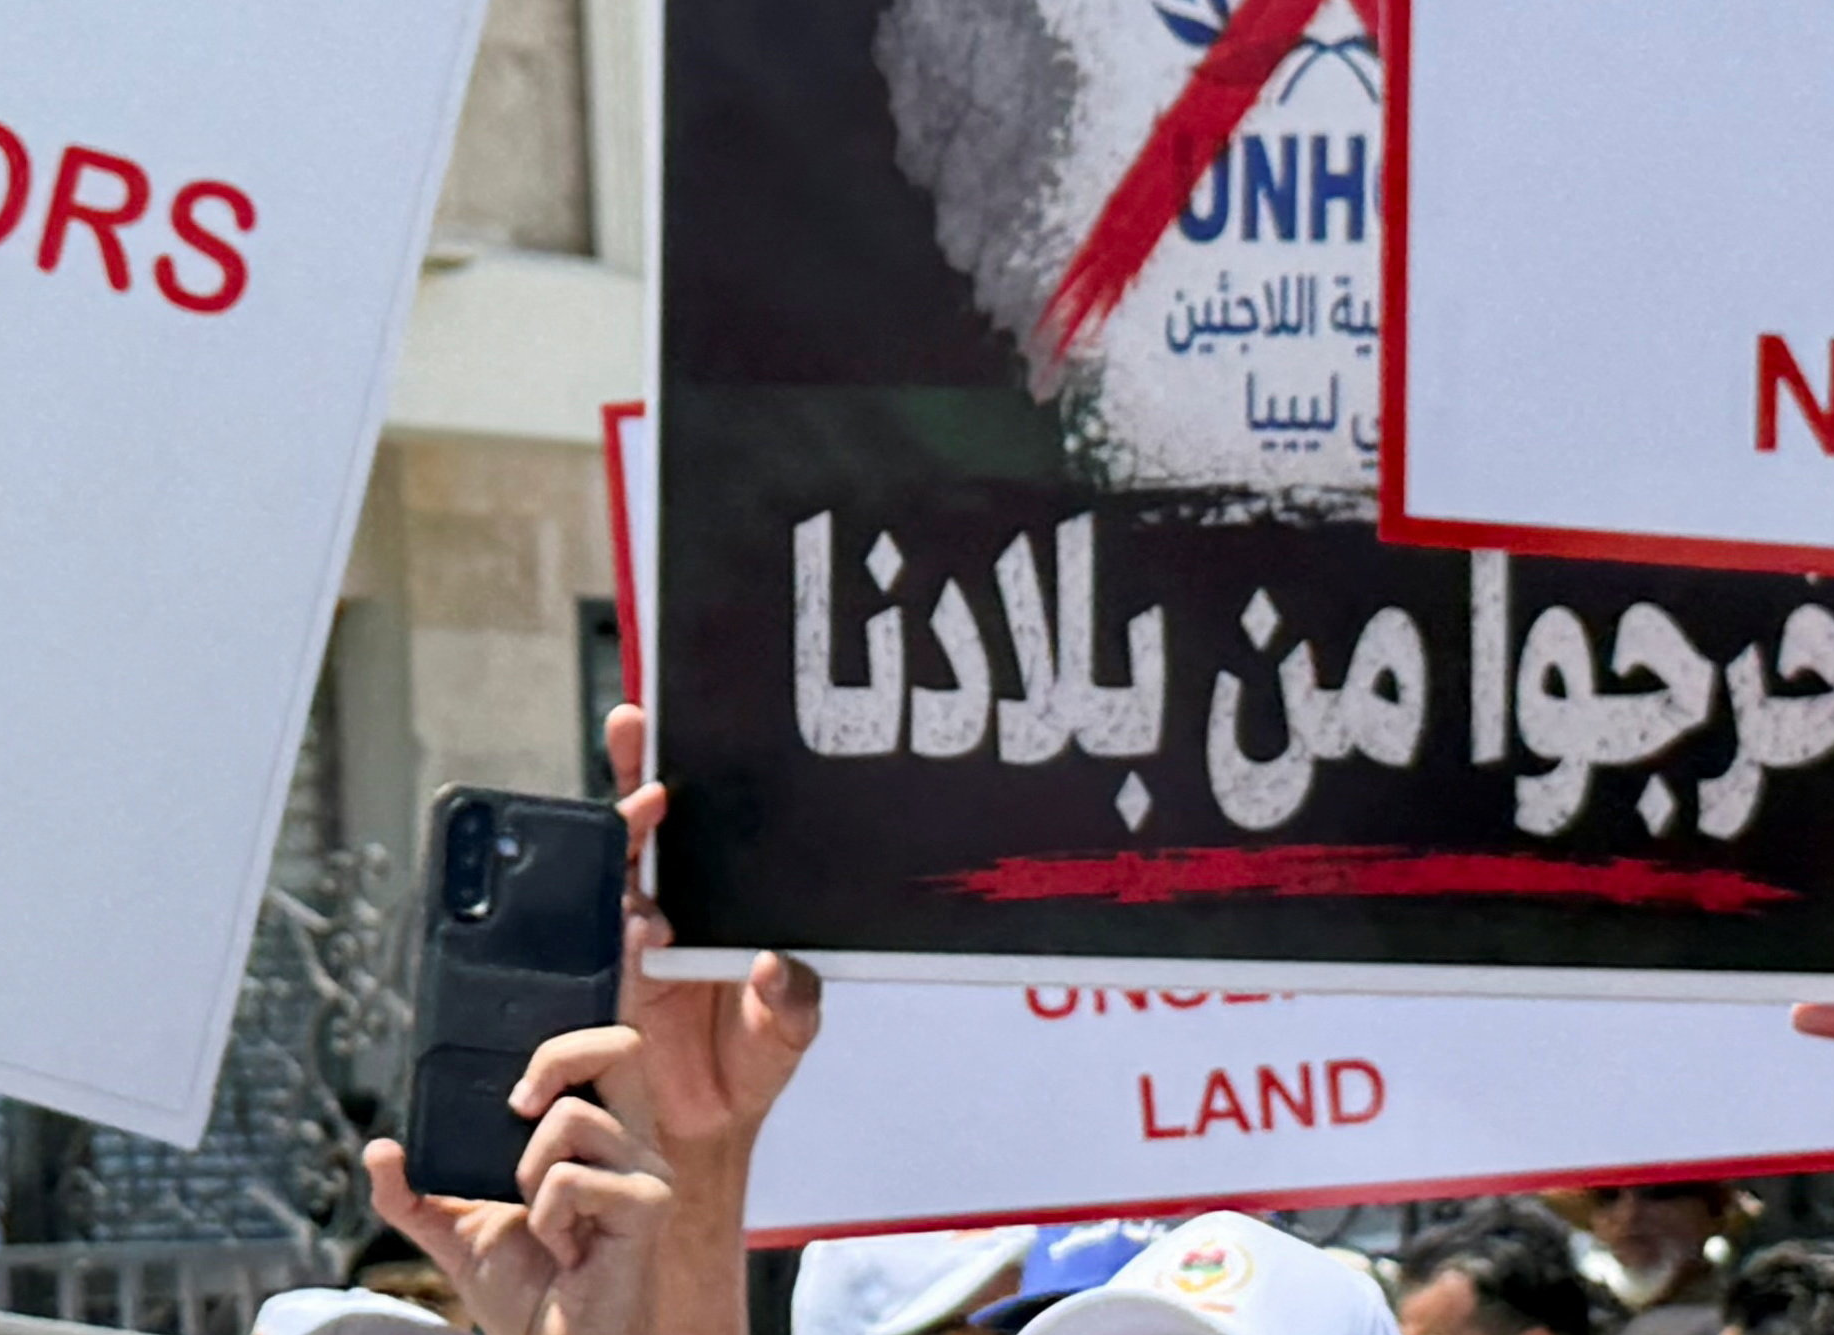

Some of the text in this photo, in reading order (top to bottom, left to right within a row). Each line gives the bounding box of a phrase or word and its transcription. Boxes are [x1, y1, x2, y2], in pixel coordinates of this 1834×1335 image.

[1175, 132, 1380, 243] UNH
[1165, 270, 1316, 354] اللاجئين
[1245, 370, 1340, 451] ليبيا
[793, 510, 1167, 832] بلادنا
[1205, 588, 1427, 831] من
[1138, 1058, 1385, 1141] LAND
